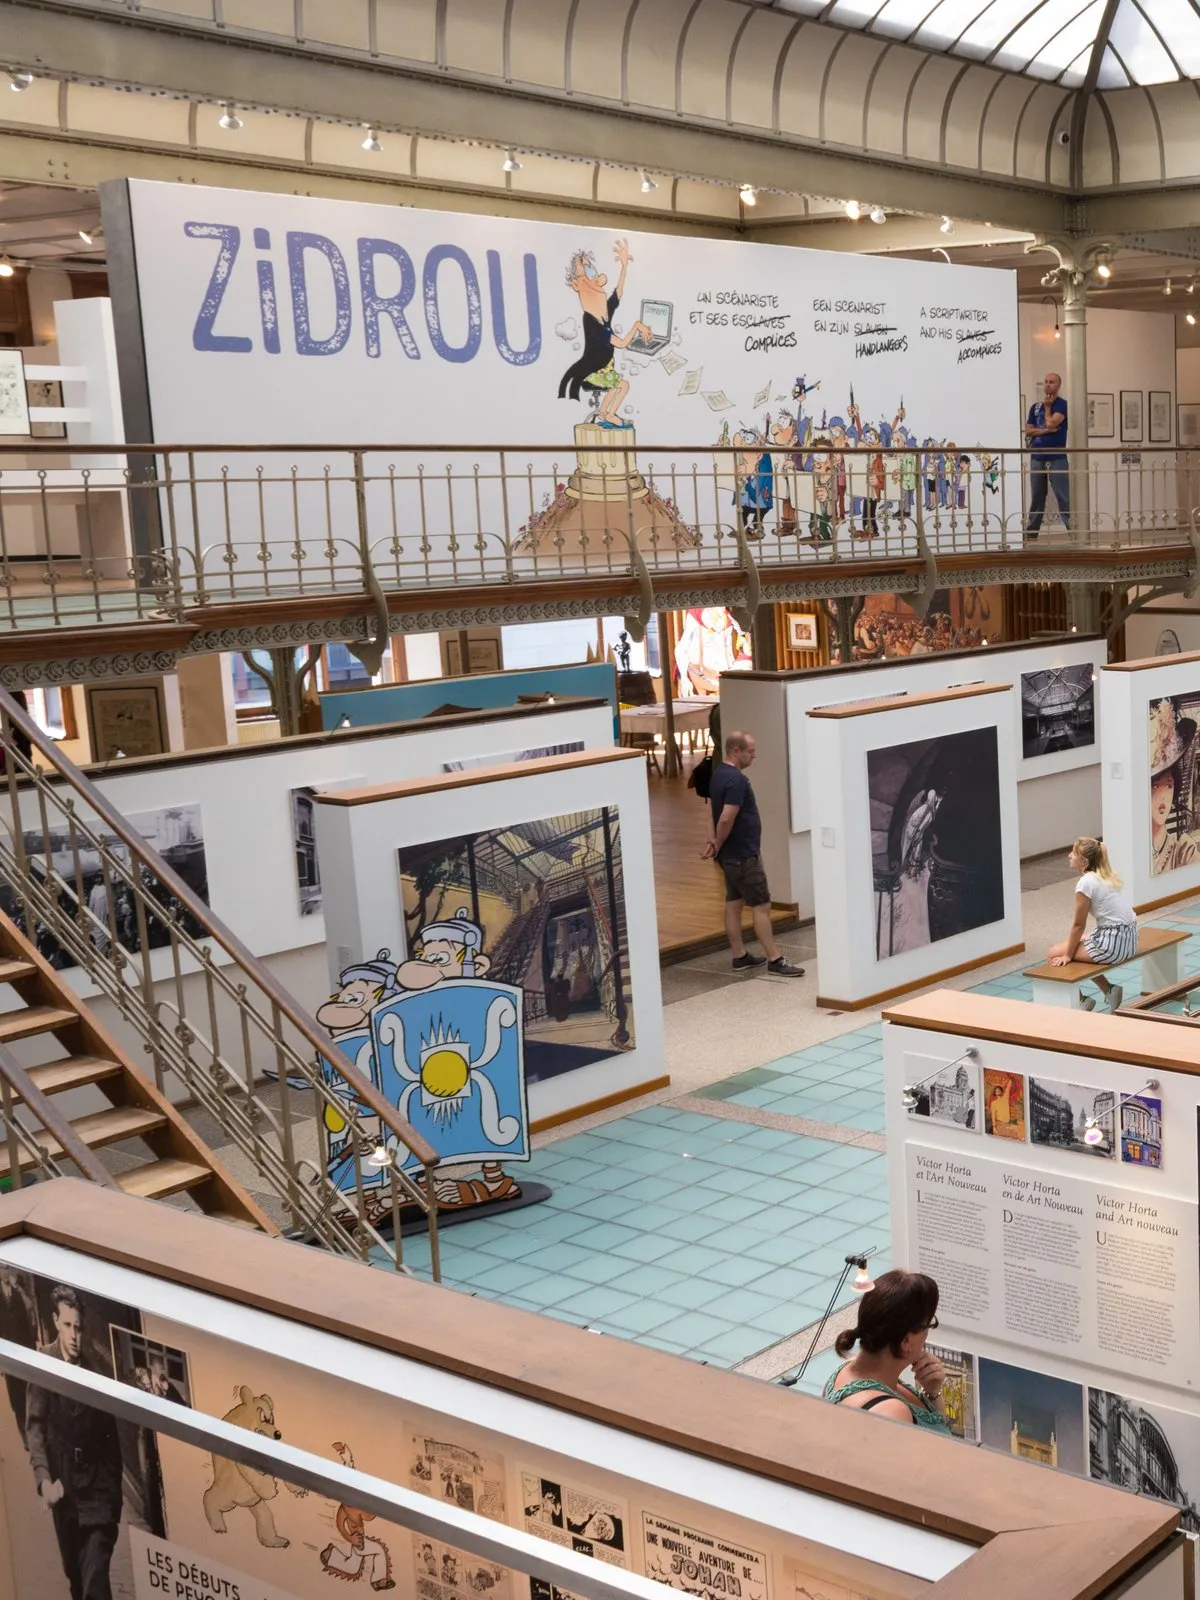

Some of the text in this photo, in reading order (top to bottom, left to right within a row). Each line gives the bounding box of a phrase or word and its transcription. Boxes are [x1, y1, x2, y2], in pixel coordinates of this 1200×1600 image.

[697, 292, 712, 303] UN
[813, 299, 832, 312] EEN
[689, 311, 704, 324] ET
[705, 313, 729, 326] SES
[920, 307, 988, 322] A SCRIPTWRITER
[814, 319, 827, 333] EN
[920, 326, 937, 339] AND
[939, 327, 953, 340] HIS
[855, 335, 908, 358] HANDLANGERS
[916, 1155, 972, 1177] Victor Horta
[916, 1171, 924, 1179] et
[947, 1175, 987, 1193] Nouveau
[1003, 1174, 1061, 1196] Victor Horta
[1002, 1190, 1084, 1215] en de Art Nouveau
[1096, 1194, 1158, 1217] Victor Horta
[1095, 1211, 1179, 1237] and Art nouveau
[645, 1517, 760, 1564] LA SEMAINE PROCHAINE COMMENCERA
[646, 1531, 658, 1547] UNE
[661, 1537, 693, 1558] NOUVELLE
[698, 1551, 736, 1575] AVENTURE
[146, 1547, 241, 1600] LES DÉBUTS
[149, 1569, 170, 1593] DE
[670, 1554, 742, 1597] JOHAN
